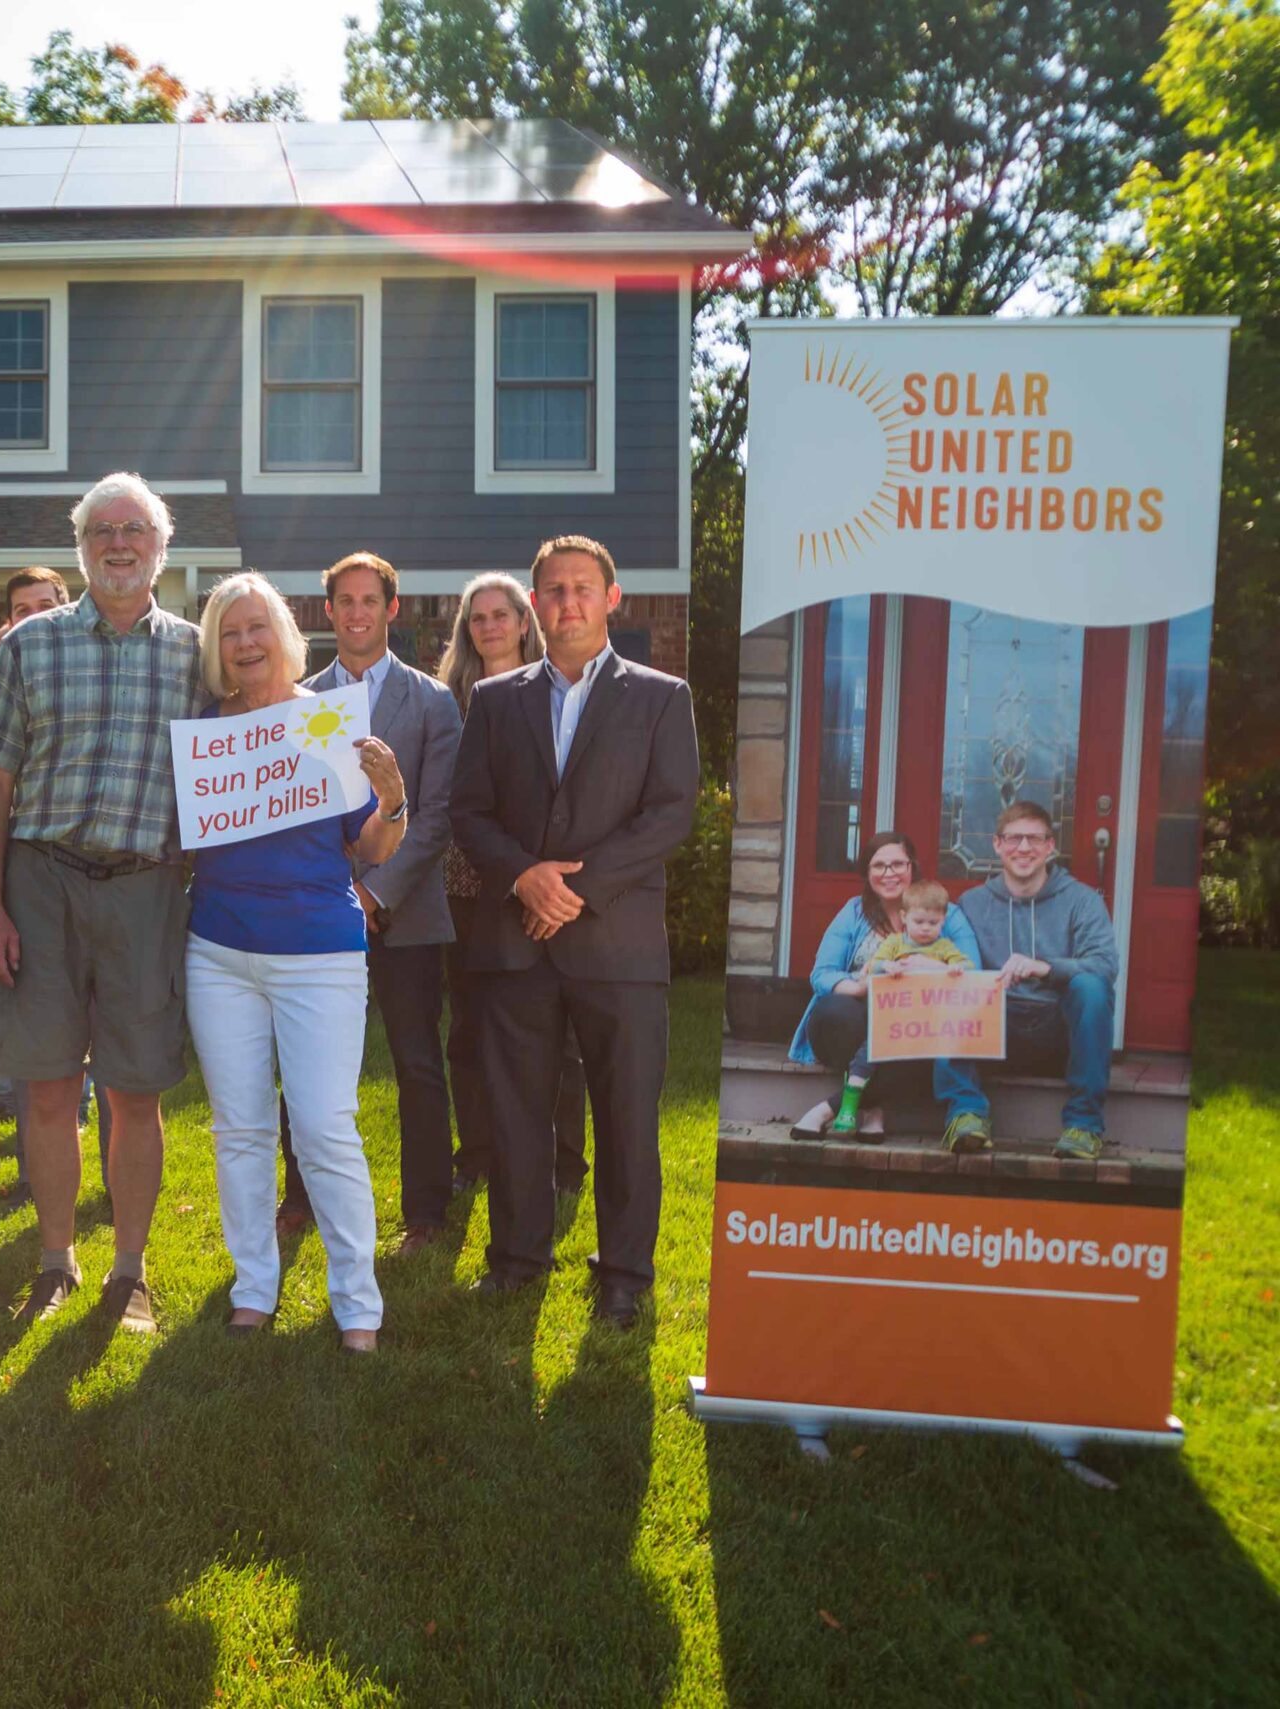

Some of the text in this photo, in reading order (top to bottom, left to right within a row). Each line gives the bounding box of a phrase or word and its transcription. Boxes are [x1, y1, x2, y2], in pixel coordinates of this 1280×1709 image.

[902, 372, 1050, 417] SOLAR
[909, 429, 1073, 475] UNITED
[896, 486, 1165, 533] NEIGHBORS
[191, 722, 287, 760] Let the
[194, 752, 302, 797] sun pay
[197, 778, 329, 839] your bills!
[877, 988, 998, 1009] WE WENT
[889, 1020, 982, 1040] SOLAR!
[725, 1210, 1169, 1280] SolarUnitedNeighbors.org
